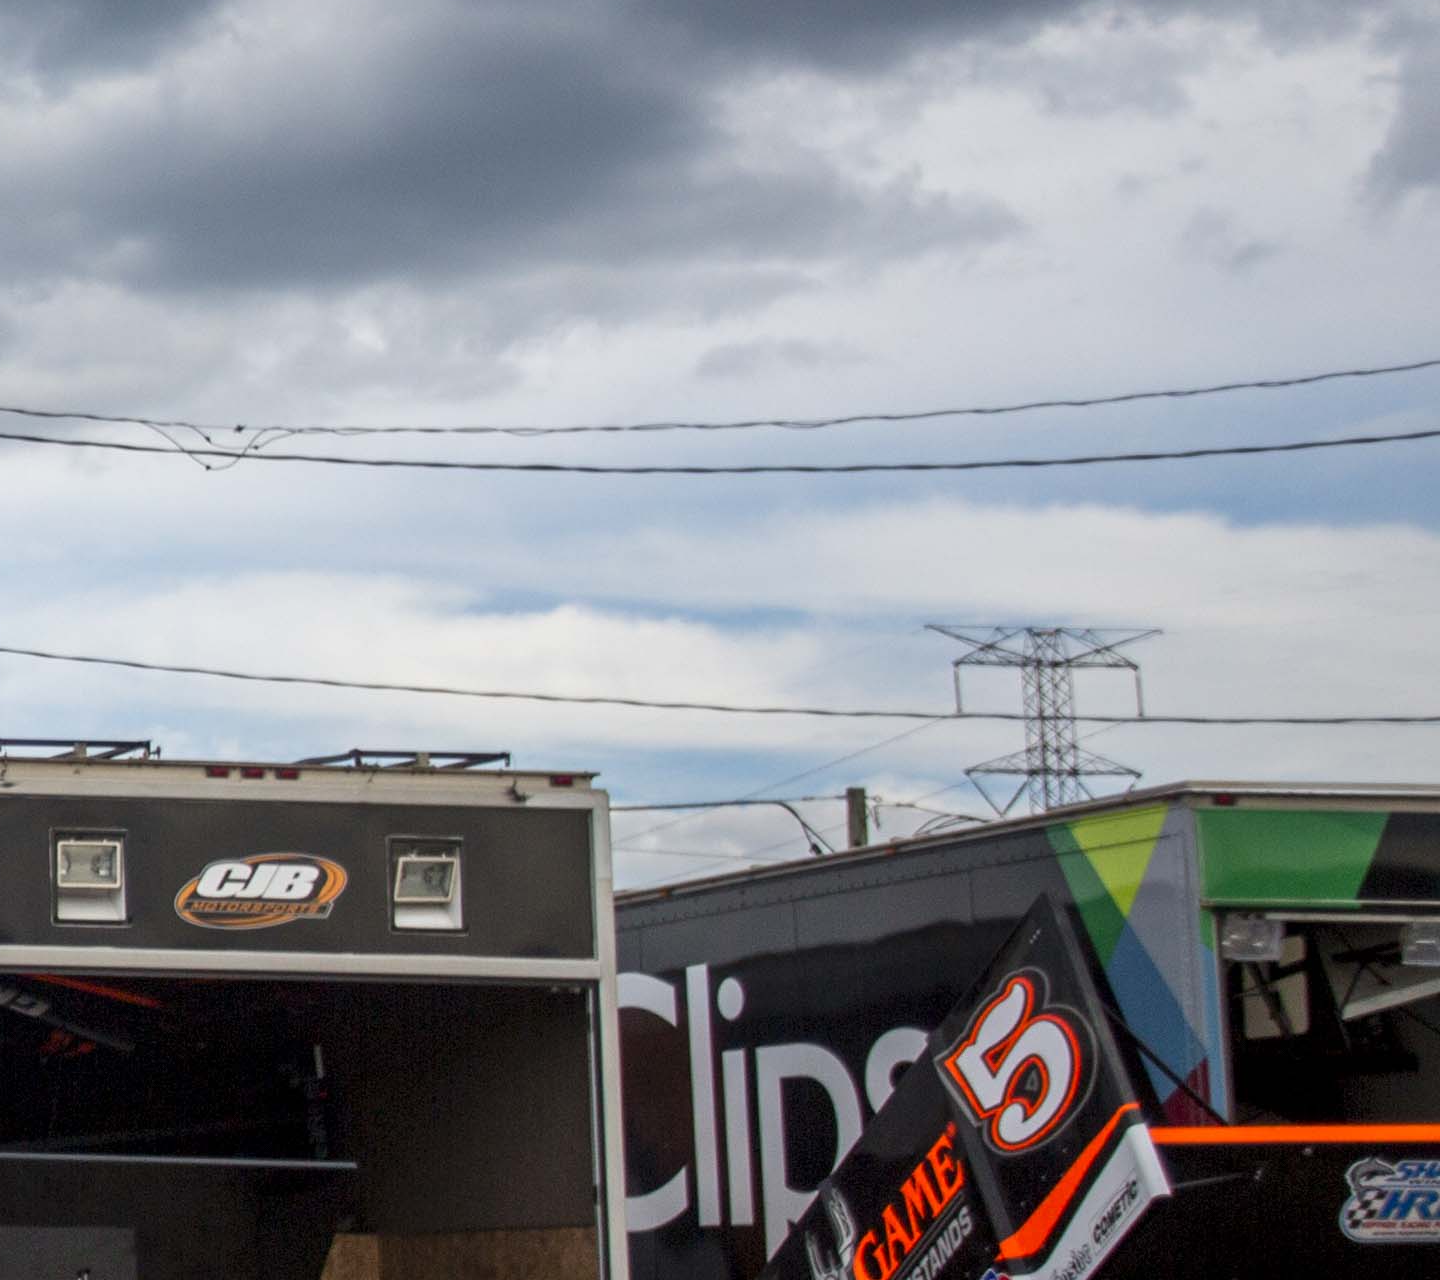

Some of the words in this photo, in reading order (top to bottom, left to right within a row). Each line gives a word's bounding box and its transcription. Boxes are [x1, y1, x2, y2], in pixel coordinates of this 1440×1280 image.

[196, 863, 320, 899] CJB
[190, 900, 320, 914] MOTORSPORTS
[943, 976, 1083, 1152] 5
[1093, 1181, 1137, 1243] COMETIC
